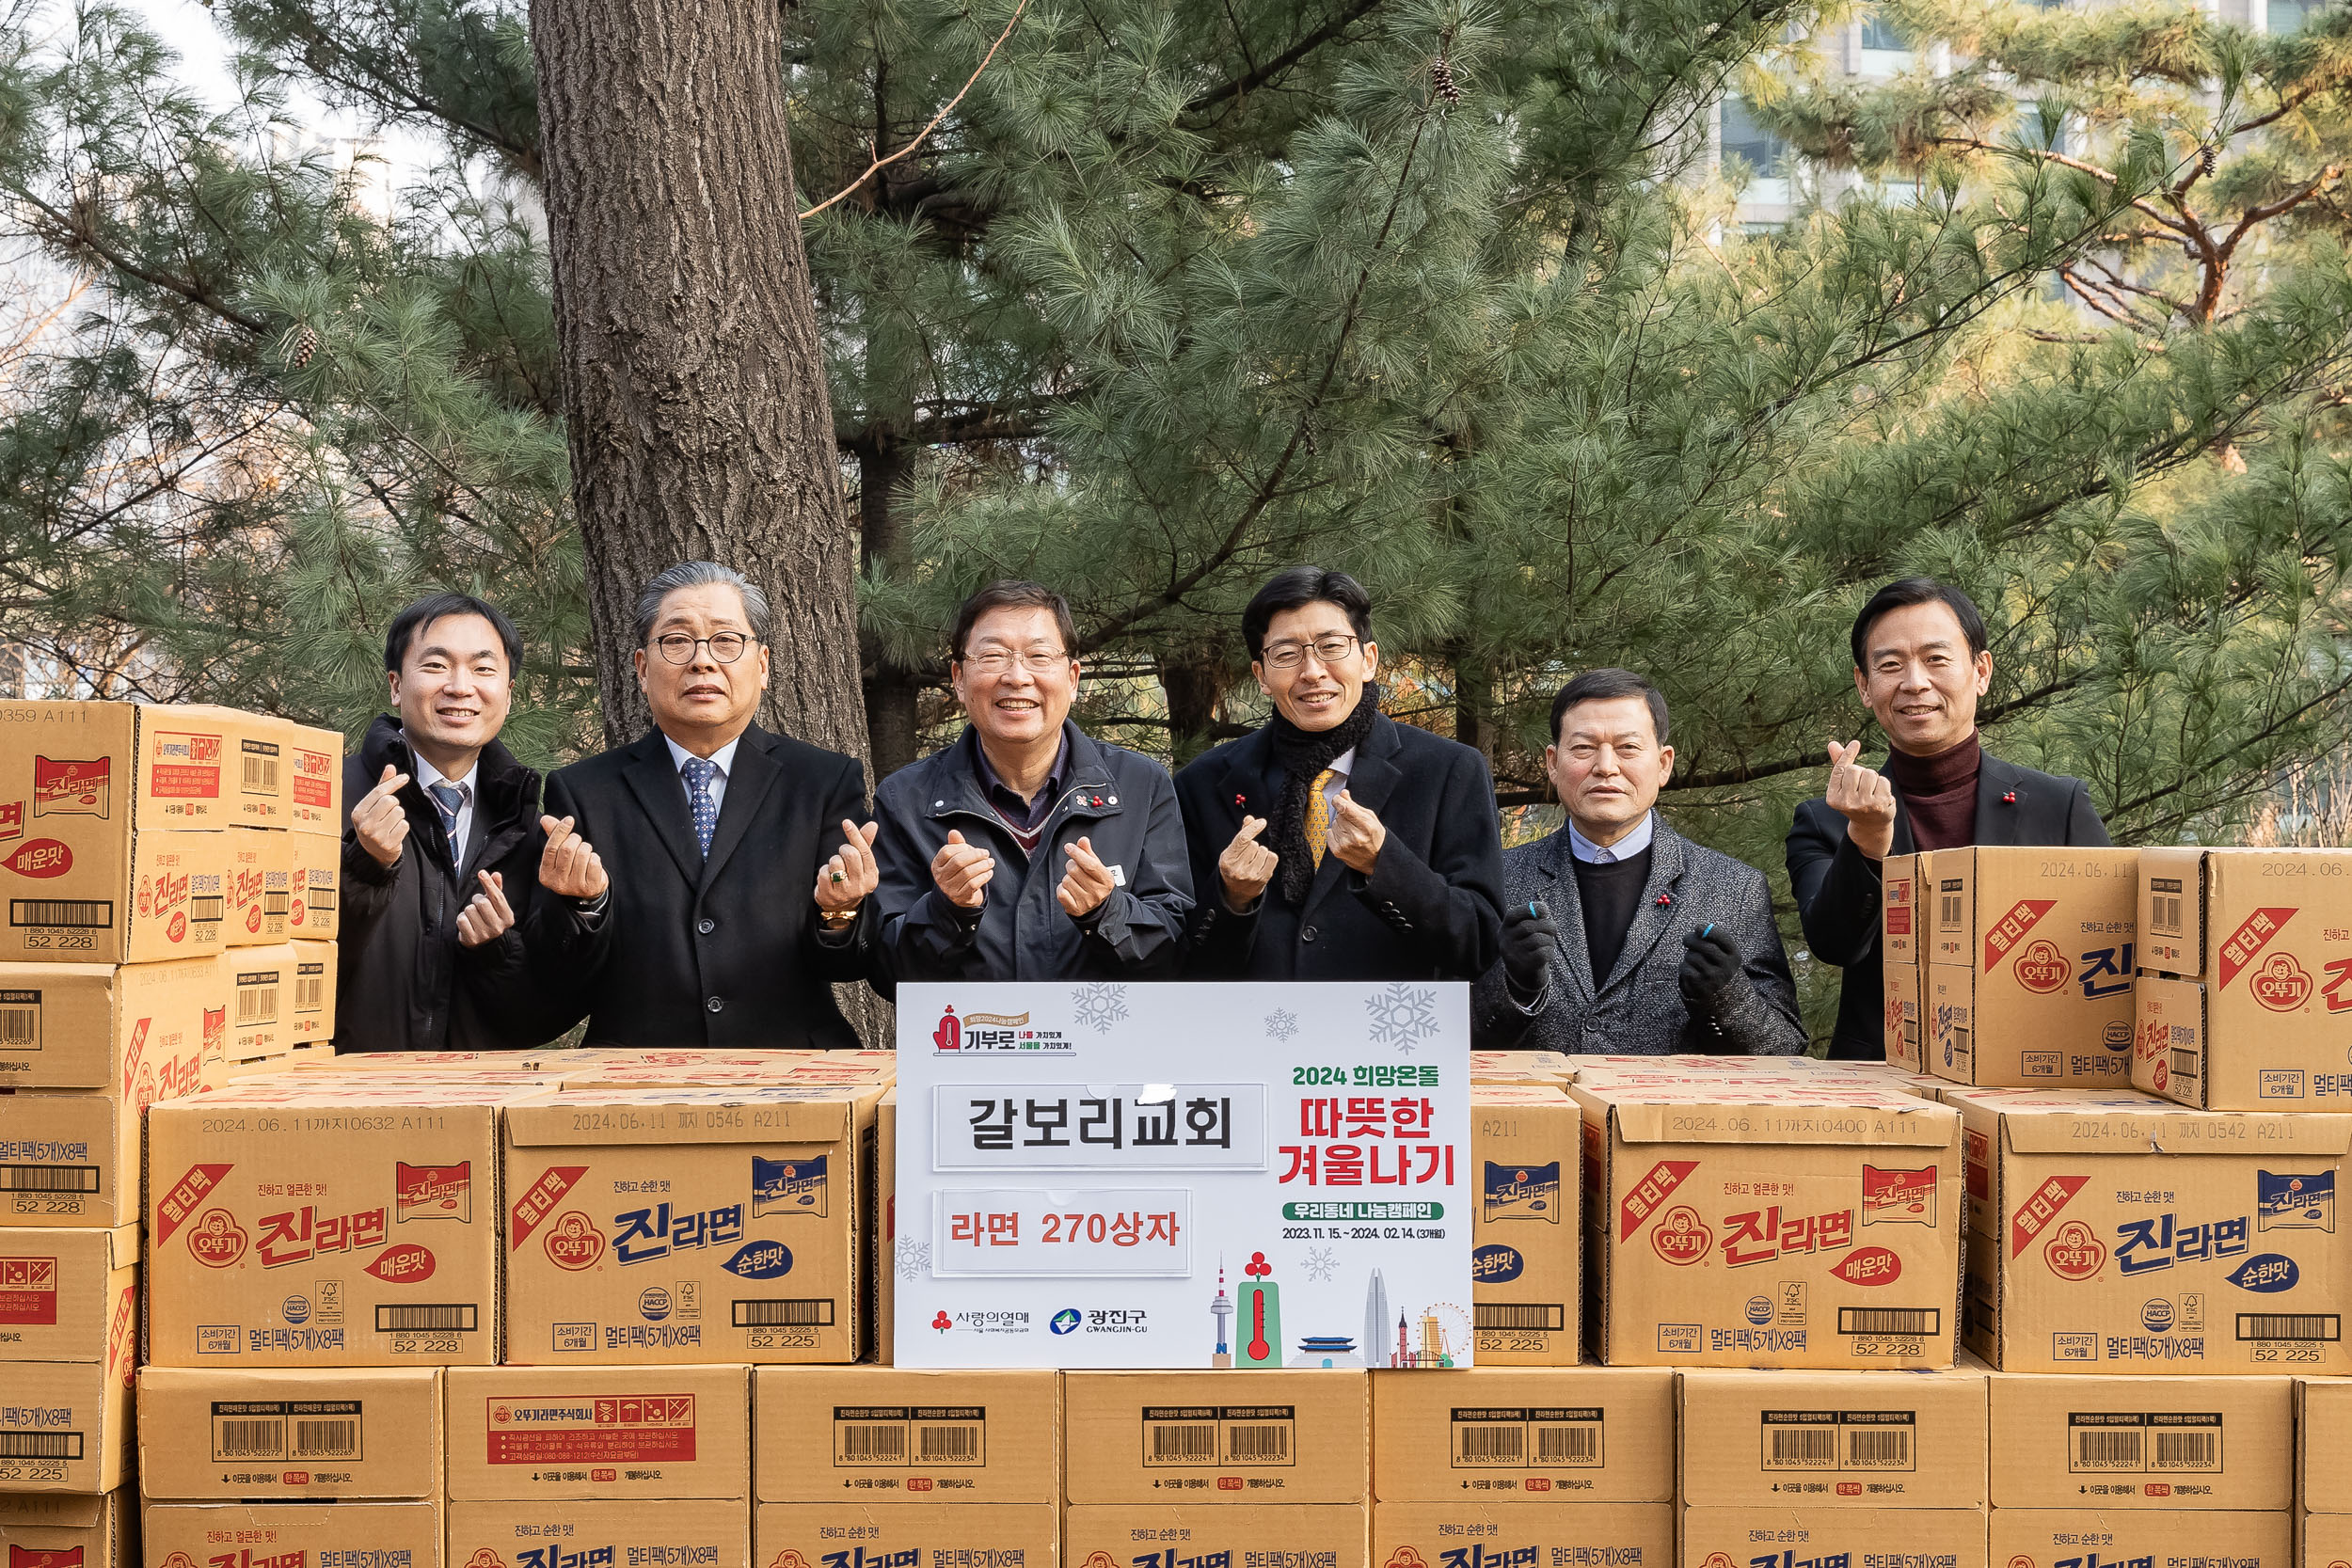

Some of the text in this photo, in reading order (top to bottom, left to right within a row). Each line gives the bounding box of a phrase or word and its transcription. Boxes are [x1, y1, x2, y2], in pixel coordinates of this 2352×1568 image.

[43, 710, 87, 722] A111
[47, 776, 98, 800] 진라면
[16, 846, 64, 871] 매운맛
[1988, 902, 2038, 953] 멀티팩
[2080, 922, 2104, 934] 진하고
[2106, 922, 2122, 934] 순한
[2323, 928, 2350, 941] 진하고
[28, 936, 93, 949] 52 228
[2222, 911, 2276, 967] 멀티팩
[2024, 966, 2061, 981] 오뚜기
[2261, 981, 2302, 998] 오뚜기
[964, 1031, 1015, 1050] 기부로
[2025, 1054, 2059, 1064] 소비기간
[1293, 1066, 1439, 1086] 2024 희망온돌
[2032, 1065, 2054, 1075] 6개월
[2264, 1073, 2300, 1083] 소비기간
[2270, 1085, 2295, 1095] 6개월
[402, 1116, 445, 1131] A111
[572, 1111, 791, 1132] 2024.06.11 까지 0546 A211
[968, 1097, 1232, 1150] 갈보리교회
[1301, 1097, 1434, 1138] 따뜻한
[1482, 1119, 1518, 1137] A211
[1873, 1119, 1917, 1134] A111
[2179, 1123, 2201, 1139] 까지
[2207, 1123, 2246, 1139] 0542
[2257, 1122, 2296, 1140] A211
[1279, 1145, 1454, 1186] 겨울나기
[159, 1166, 215, 1224] 멀티팩
[257, 1182, 327, 1196] 진하고 얼큰한 맛!
[406, 1180, 460, 1205] 진라면
[613, 1180, 671, 1194] 진하고 순한 맛!
[763, 1176, 815, 1200] 진라면
[1495, 1181, 1546, 1206] 진라면
[1624, 1163, 1678, 1220] 멀티팩
[1724, 1182, 1794, 1196] 진하고 얼큰한 맛!
[515, 1169, 570, 1226] 멀티팩
[1874, 1184, 1926, 1210] 진라면
[2116, 1190, 2175, 1204] 진하고 순한 맛!
[2270, 1189, 2322, 1213] 진라면
[16, 1201, 80, 1212] 52 228
[1294, 1203, 1432, 1219] 우리동네 나눔캠페인
[2015, 1179, 2070, 1236] 멀티팩
[255, 1205, 389, 1270] 진라면
[612, 1201, 745, 1267] 진라면
[950, 1211, 1180, 1247] 라면 270상자
[1720, 1206, 1853, 1269] 진라면
[197, 1237, 238, 1254] 오뚜기
[554, 1239, 596, 1259] 오뚜기
[1661, 1235, 1702, 1251] 오뚜기
[2114, 1212, 2251, 1277] 진라면
[379, 1252, 427, 1277] 매운맛
[736, 1247, 785, 1275] 순한맛
[2055, 1249, 2097, 1267] 오뚜기
[1845, 1254, 1894, 1281] 매운맛
[2241, 1261, 2290, 1288] 순한맛
[956, 1311, 1029, 1327] 사랑의열매
[1088, 1309, 1147, 1324] 광진구
[201, 1328, 236, 1339] 소비기간
[249, 1327, 344, 1352] 멀티팩(5개)X8팩
[557, 1327, 593, 1338] 소비기간
[605, 1323, 701, 1349] 멀티팩(5개)X8팩
[751, 1335, 815, 1347] 52 225
[1661, 1327, 1698, 1338] 소비기간
[1710, 1327, 1807, 1353] 멀티팩(5개)X8팩
[208, 1339, 231, 1351] 6개월
[394, 1340, 458, 1352] 52 228
[564, 1338, 587, 1348] 6개월
[1480, 1339, 1543, 1350] 52 225
[1669, 1338, 1692, 1350] 6개월
[1856, 1344, 1920, 1355] 52 228
[2058, 1336, 2093, 1347] 소비기간
[2106, 1336, 2204, 1360] 멀티팩(5개)X8팩
[2064, 1347, 2088, 1358] 6개월
[2255, 1350, 2320, 1362] 52 225
[514, 1408, 593, 1422] 오뚜기라면주식회사
[0, 1468, 63, 1480] 52 225
[232, 1473, 251, 1484] 이곳을
[252, 1473, 277, 1484] 이용해서
[207, 1530, 277, 1544] 진하고 얼큰한 맛!
[515, 1525, 574, 1537] 진하고 순한 맛!
[627, 1545, 718, 1567] 멀티팩(5개)X8팩
[1551, 1546, 1643, 1567] 멀티팩(5개)X8팩
